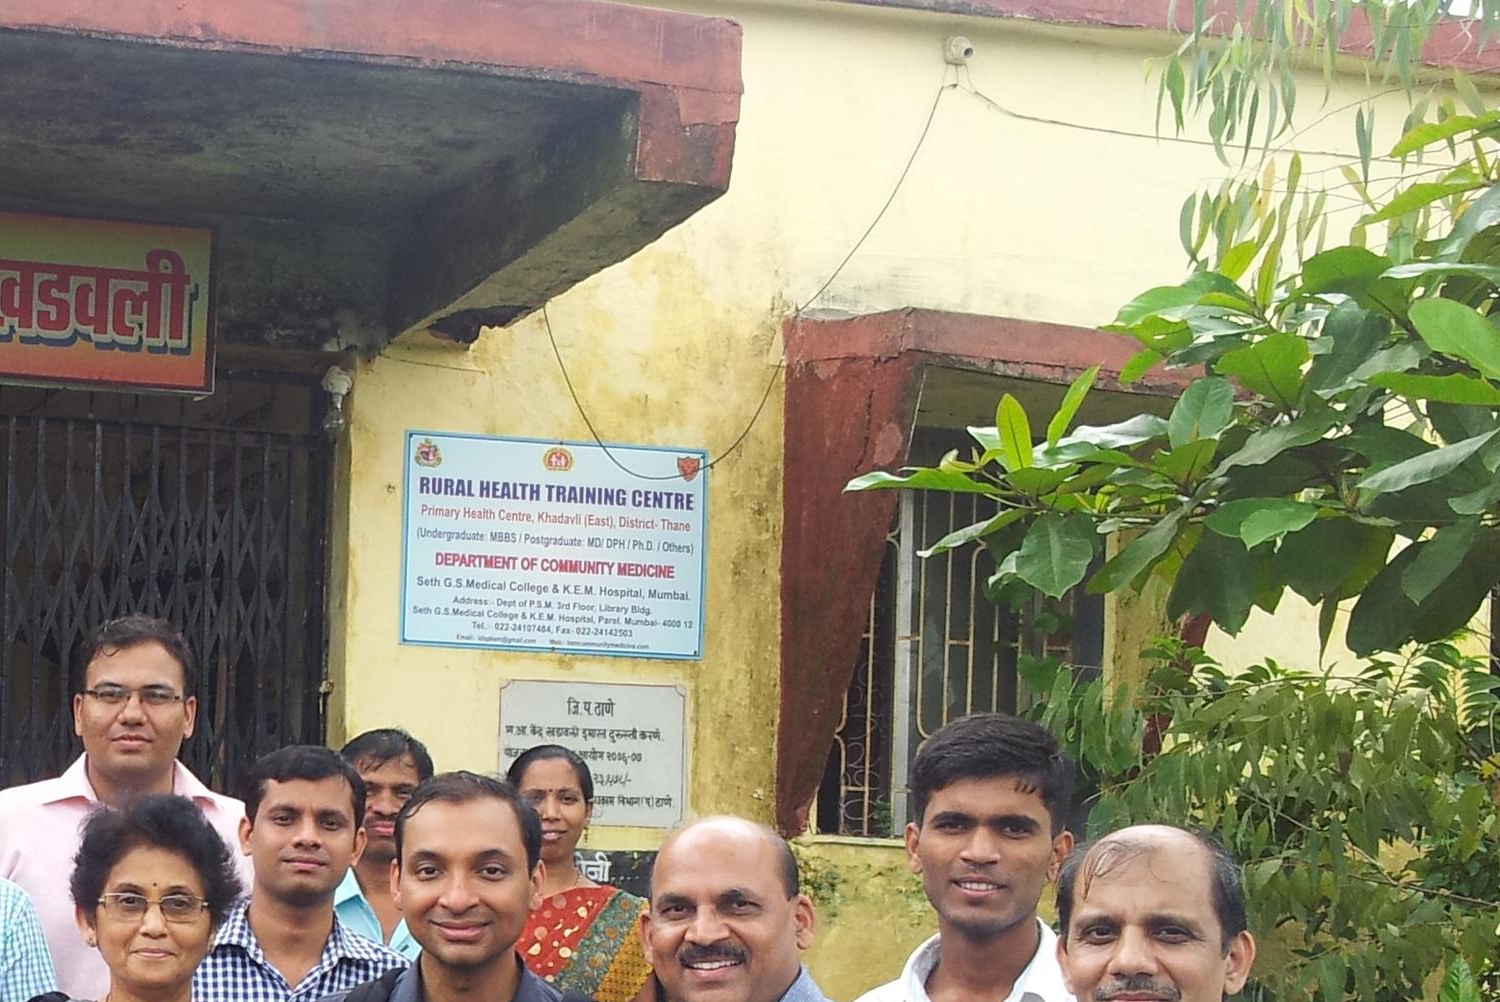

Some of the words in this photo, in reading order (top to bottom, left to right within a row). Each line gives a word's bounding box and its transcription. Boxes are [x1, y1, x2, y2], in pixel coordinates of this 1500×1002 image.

[419, 476, 475, 497] RURAL
[479, 480, 541, 502] HEALTH
[545, 484, 627, 507] TRAINING
[631, 489, 694, 511] CENTRE
[420, 503, 461, 521] Primary
[463, 506, 495, 520] Health
[498, 508, 535, 525] Centre,
[537, 511, 582, 526] Khadavli
[584, 513, 616, 530] (East),
[660, 518, 691, 533] Thane
[489, 531, 517, 543] MBBS
[606, 537, 625, 550] DPH
[662, 541, 694, 556] Others)
[435, 552, 518, 572] DEPARTMENT
[520, 556, 538, 572] OF
[541, 558, 615, 576] COMMUNITY
[616, 562, 676, 579] MEDICINE
[416, 575, 441, 588] Seth
[509, 580, 549, 595] College
[552, 583, 560, 594] &
[562, 583, 596, 596] K.E.M.
[599, 585, 645, 599] Hospital,
[648, 588, 691, 601] Mumbai.
[412, 606, 433, 616] Seth
[486, 609, 519, 621] College
[521, 611, 527, 621] &
[558, 613, 596, 625] Hospital,
[683, 620, 693, 629] 12
[496, 597, 517, 609] Dept
[518, 599, 528, 608] of
[556, 601, 571, 610] 3rd
[599, 603, 630, 615] Library
[631, 605, 653, 616] Bldg.
